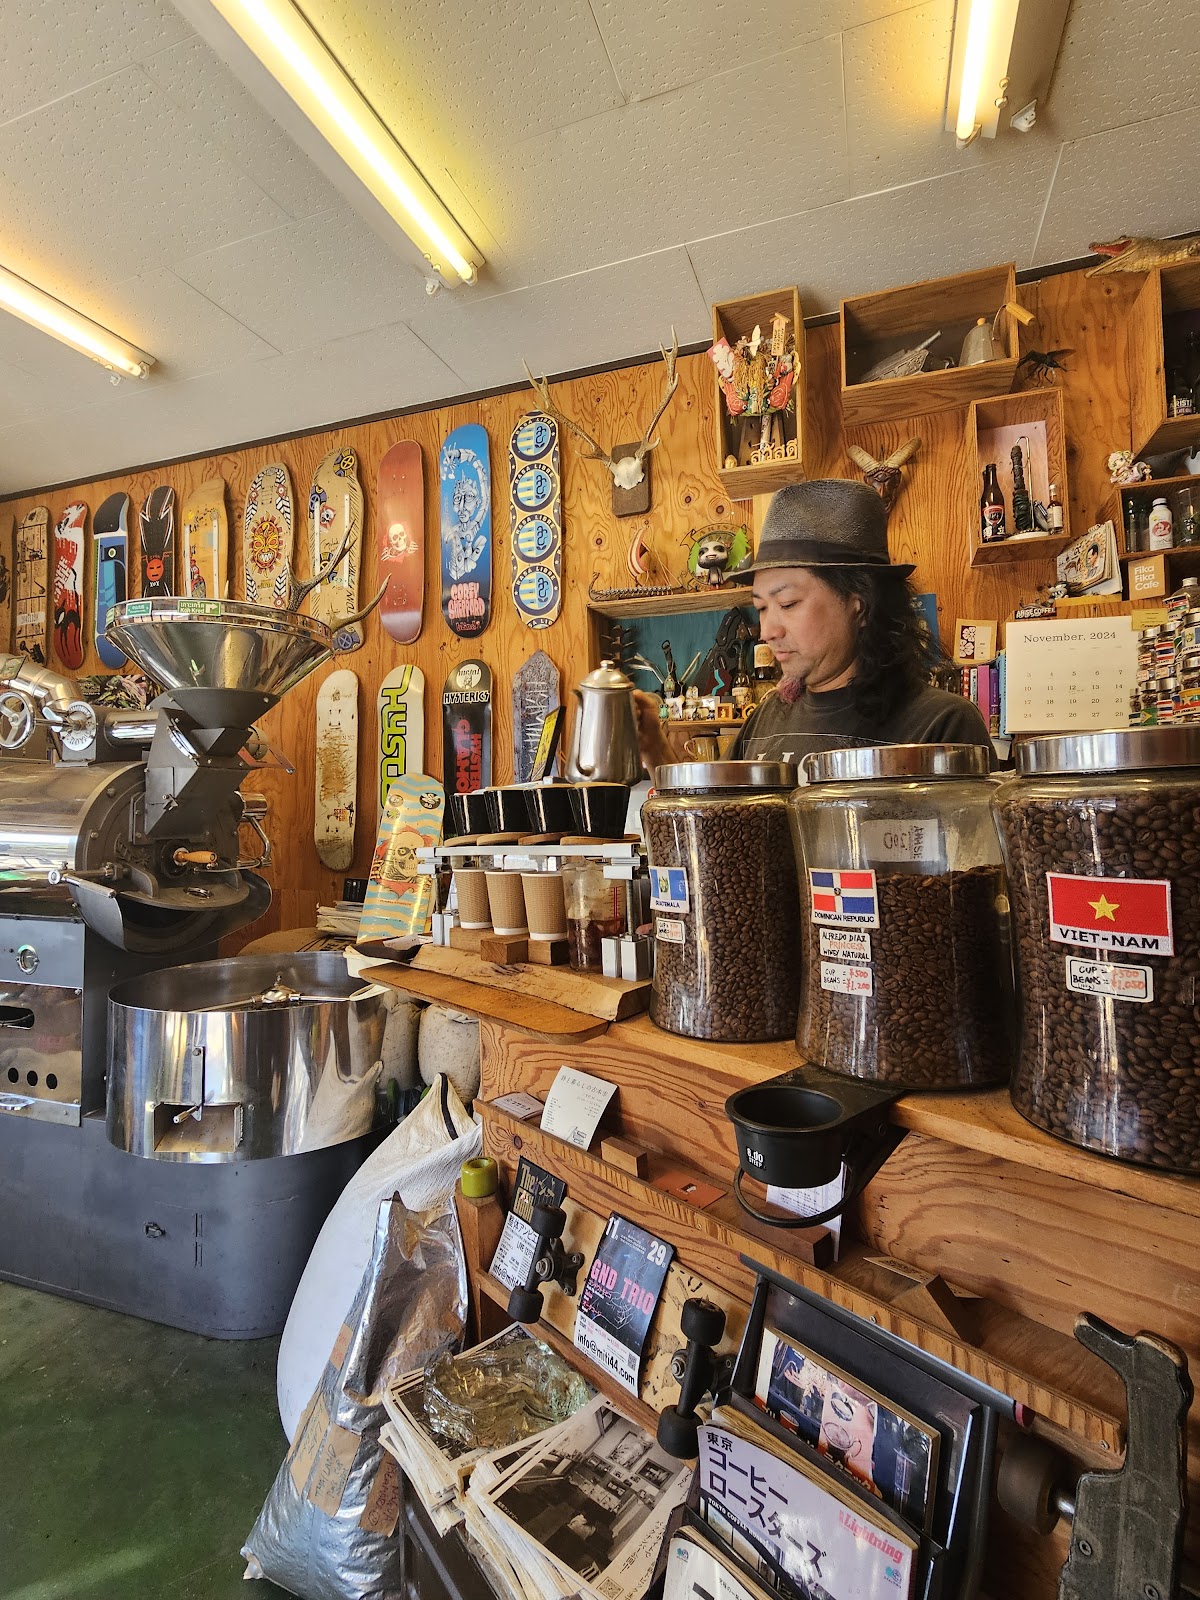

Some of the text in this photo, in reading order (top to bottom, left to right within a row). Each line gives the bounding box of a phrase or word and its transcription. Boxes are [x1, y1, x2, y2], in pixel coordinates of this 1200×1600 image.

[534, 464, 554, 478] LIBRE
[534, 514, 555, 528] LIBRE
[536, 565, 555, 581] LIBRE
[1134, 566, 1155, 575] Fika
[1134, 573, 1155, 582] Fika
[451, 582, 480, 600] COREY
[1135, 581, 1159, 591] Cafe
[1090, 632, 1116, 640] 2024
[443, 691, 490, 705] HYSTERICS
[814, 911, 875, 923] DOMINICAN REPUBLIC
[822, 931, 867, 943] ALFREDO DIAZ
[1059, 927, 1159, 950] VIET-NAM
[842, 950, 870, 960] NATURAL
[825, 968, 836, 976] CUP
[1078, 965, 1098, 975] CUP
[823, 975, 841, 984] BEANS
[1073, 974, 1101, 985] BEANS
[590, 1258, 618, 1290] GND
[620, 1276, 655, 1315] TRIO
[706, 1431, 733, 1453] 東京
[709, 1446, 789, 1505] コーヒー
[707, 1497, 727, 1516] TOKYO
[727, 1509, 748, 1531] COFFEE
[709, 1470, 828, 1579] ロースターズ
[844, 1513, 904, 1565] Lightning
